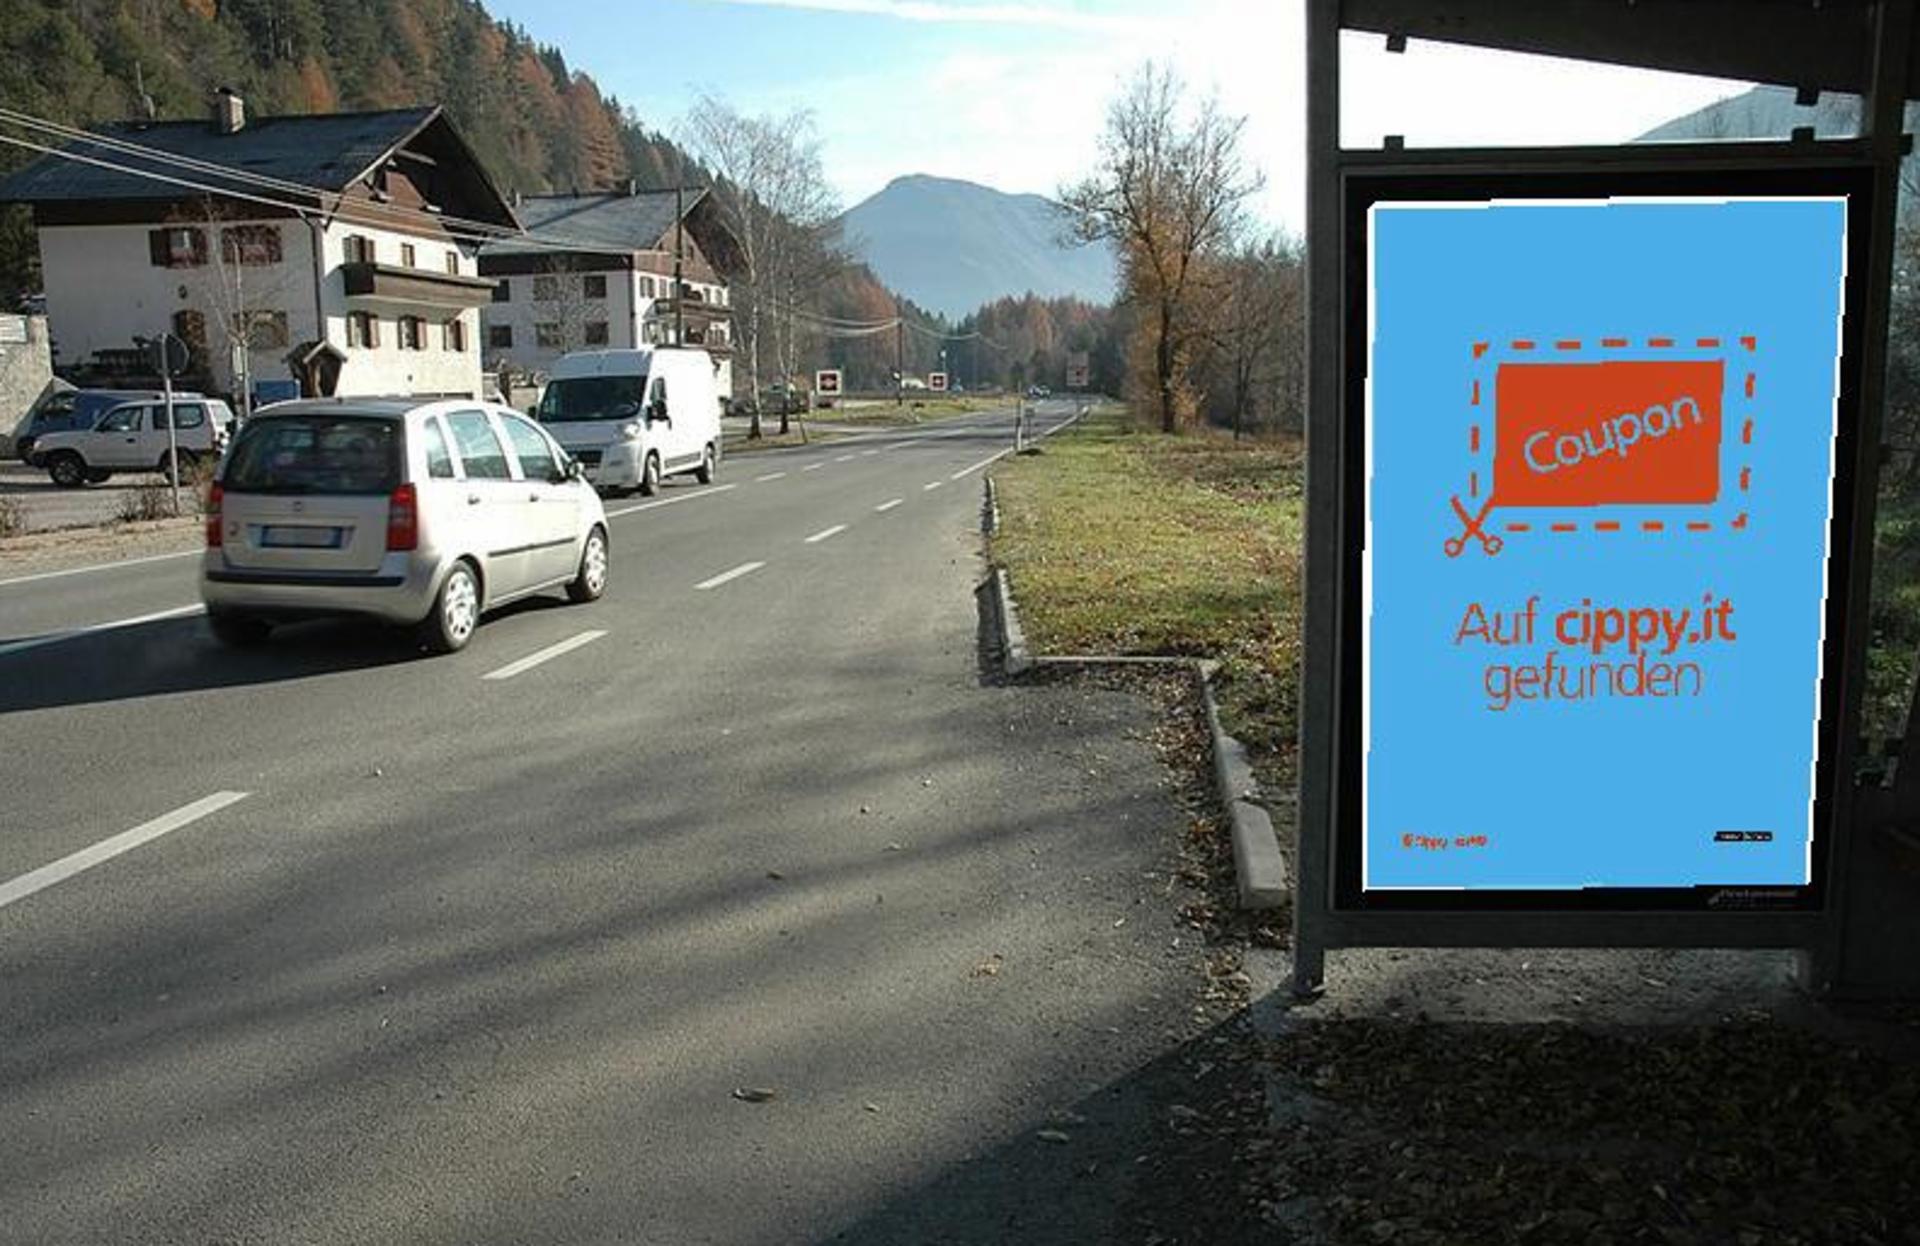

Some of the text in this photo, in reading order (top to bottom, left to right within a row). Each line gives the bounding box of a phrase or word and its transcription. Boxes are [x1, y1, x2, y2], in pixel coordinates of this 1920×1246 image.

[1523, 396, 1702, 474] Coupon
[1456, 592, 1738, 654] Auf cippy.it
[1484, 651, 1703, 711] gefunden
